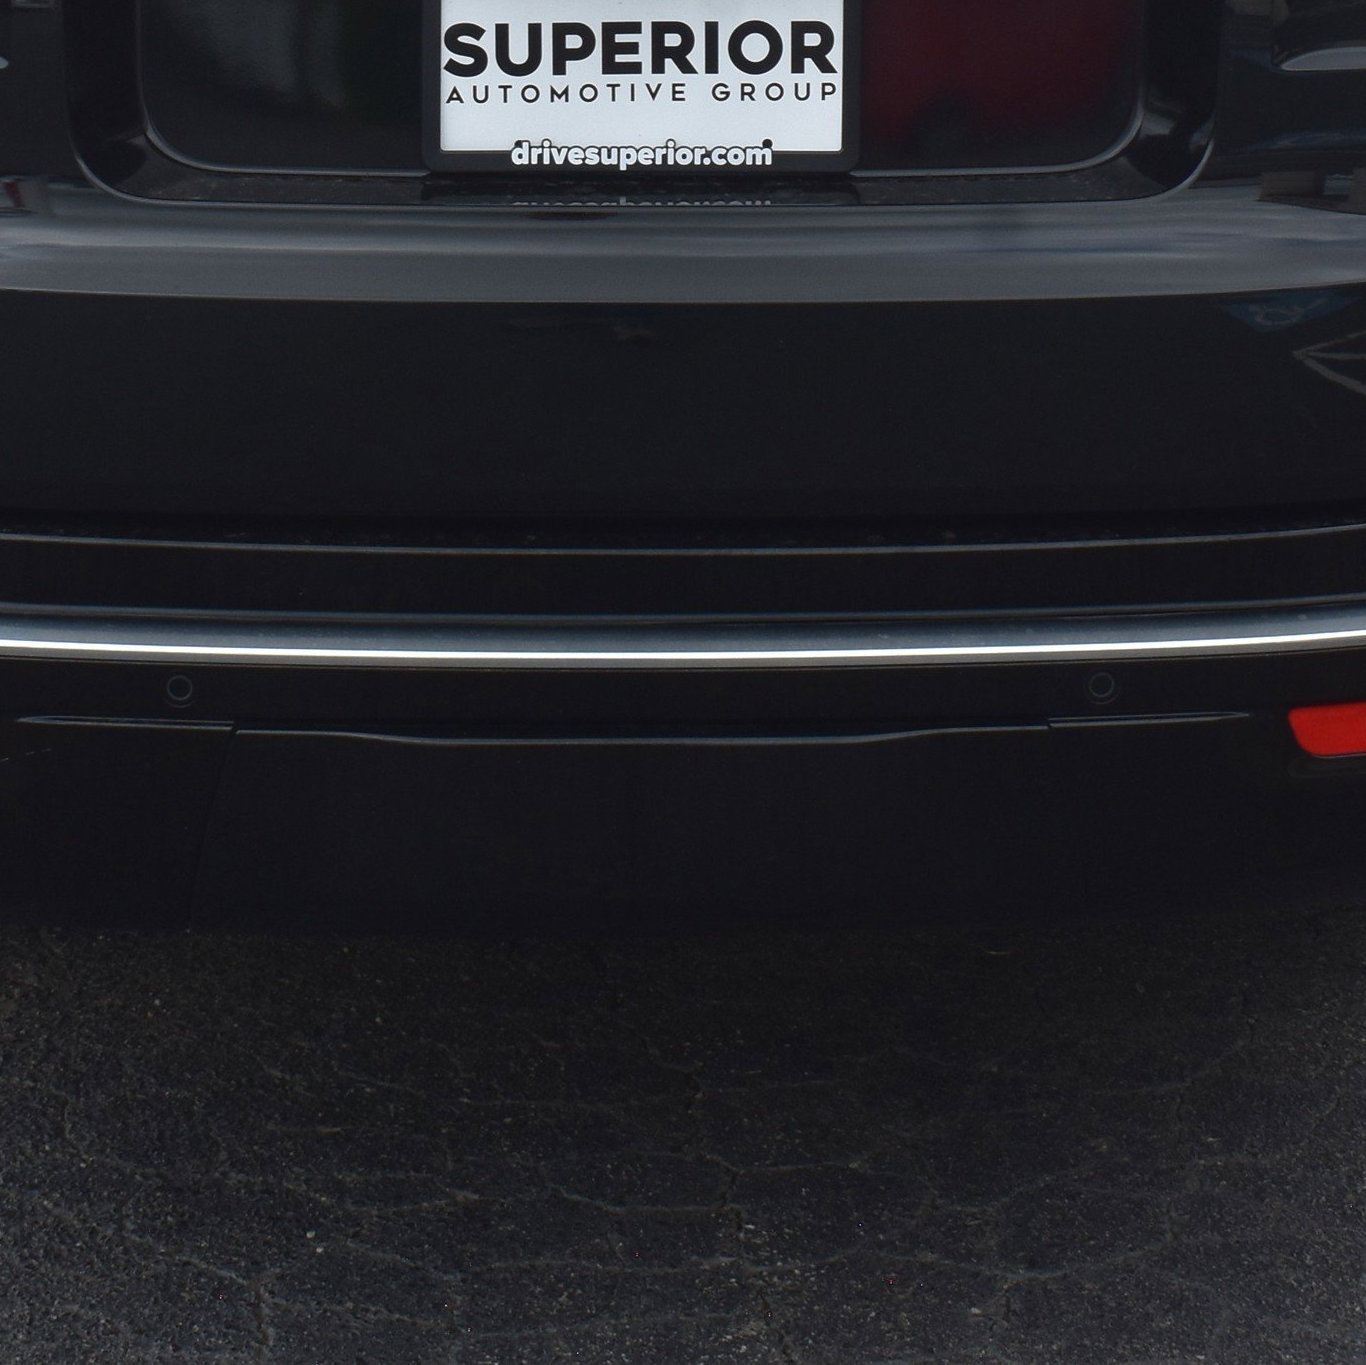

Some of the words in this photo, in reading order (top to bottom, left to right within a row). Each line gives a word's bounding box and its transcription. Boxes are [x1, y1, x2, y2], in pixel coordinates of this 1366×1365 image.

[443, 20, 838, 77] SUPERIOR
[446, 83, 686, 104] AUTOMOTIVE
[711, 82, 837, 102] GROUP
[511, 140, 773, 171] drivesuperior.com
